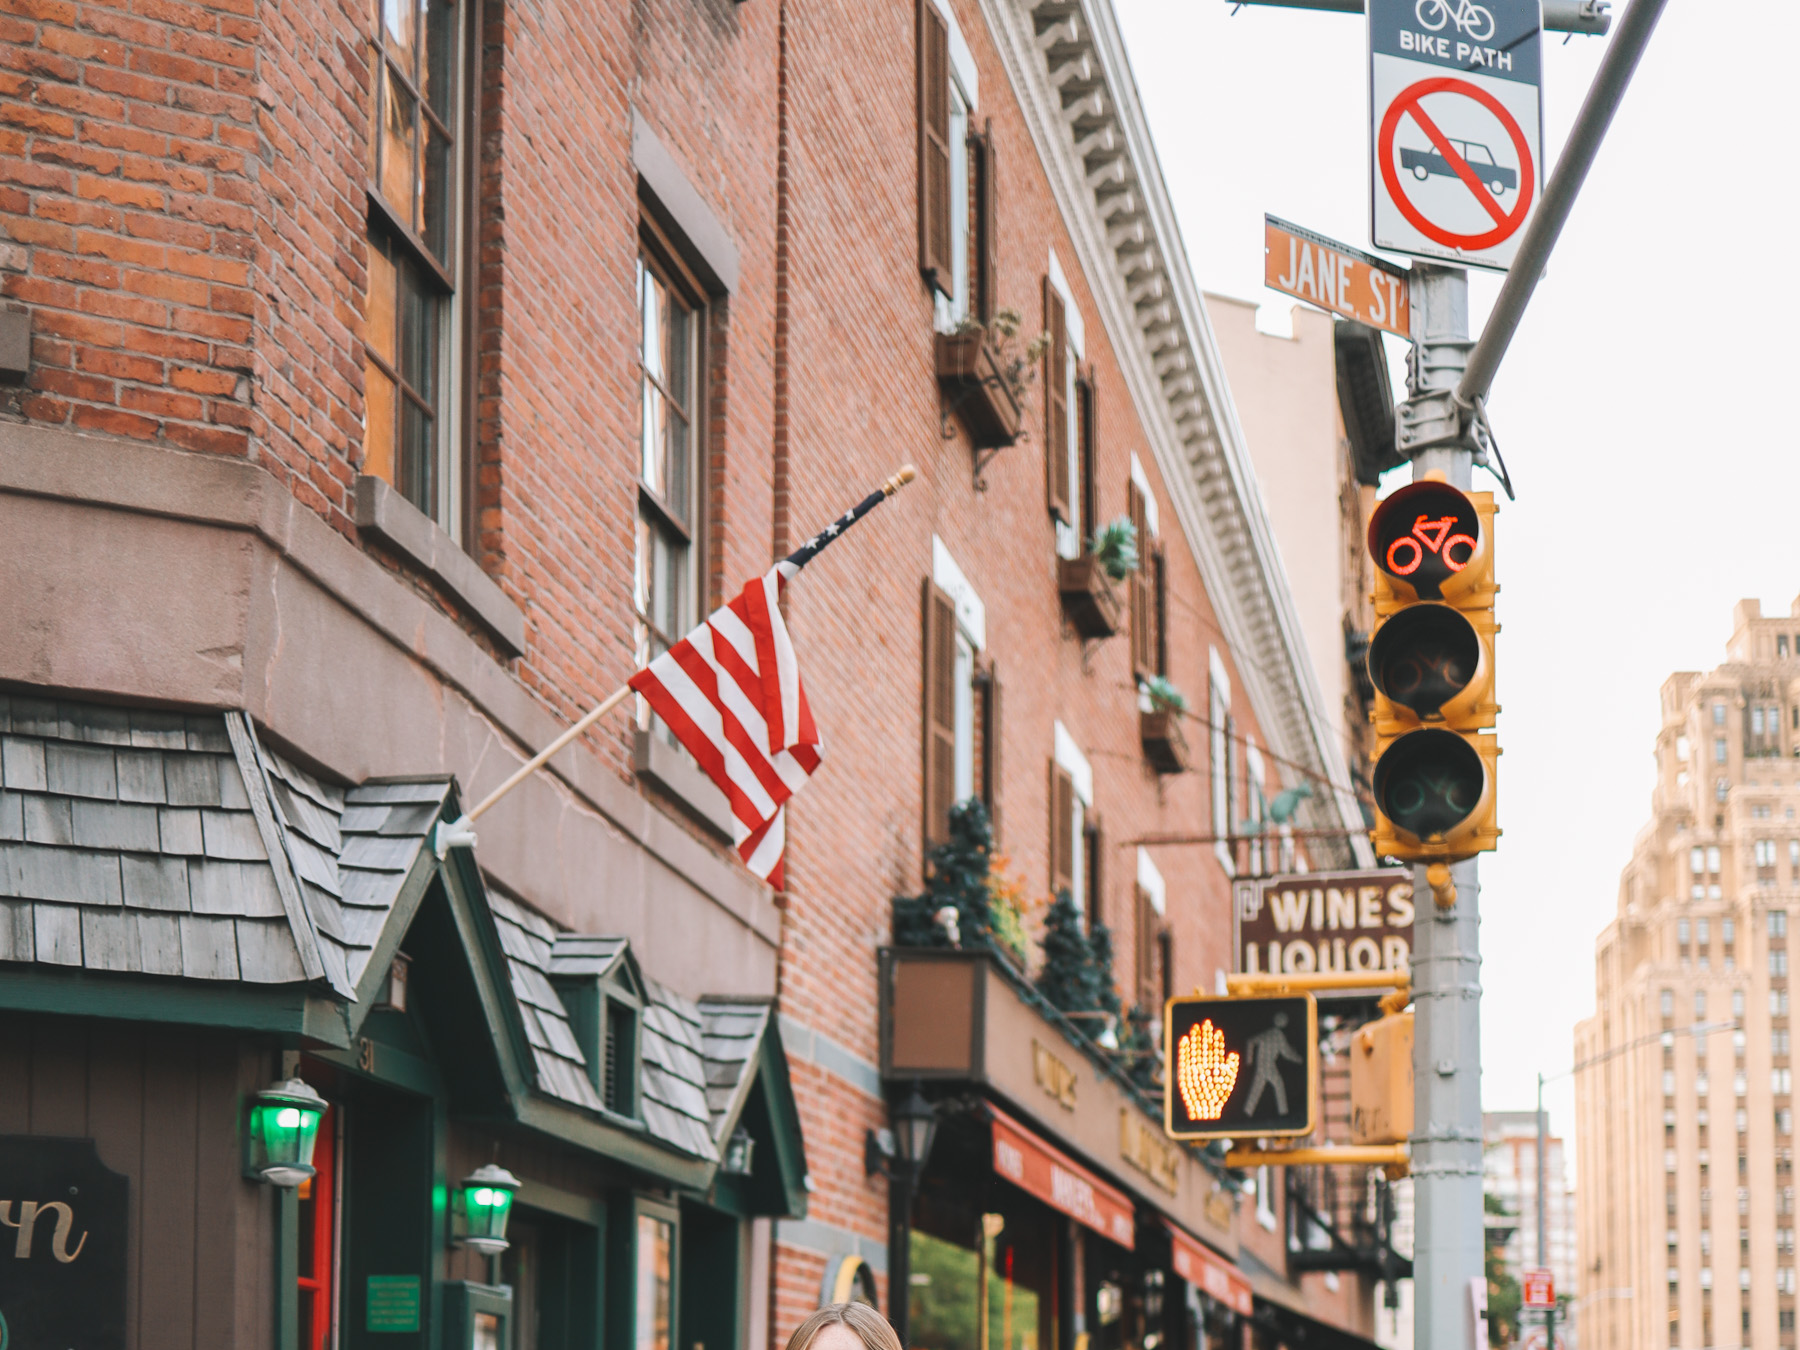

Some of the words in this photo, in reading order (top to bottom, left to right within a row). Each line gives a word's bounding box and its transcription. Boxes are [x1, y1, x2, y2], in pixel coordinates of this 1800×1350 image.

[1399, 29, 1451, 59] BIKE
[1456, 41, 1512, 72] PATH
[1278, 237, 1354, 312] JANE
[1368, 269, 1400, 329] ST
[1267, 883, 1416, 933] WINES
